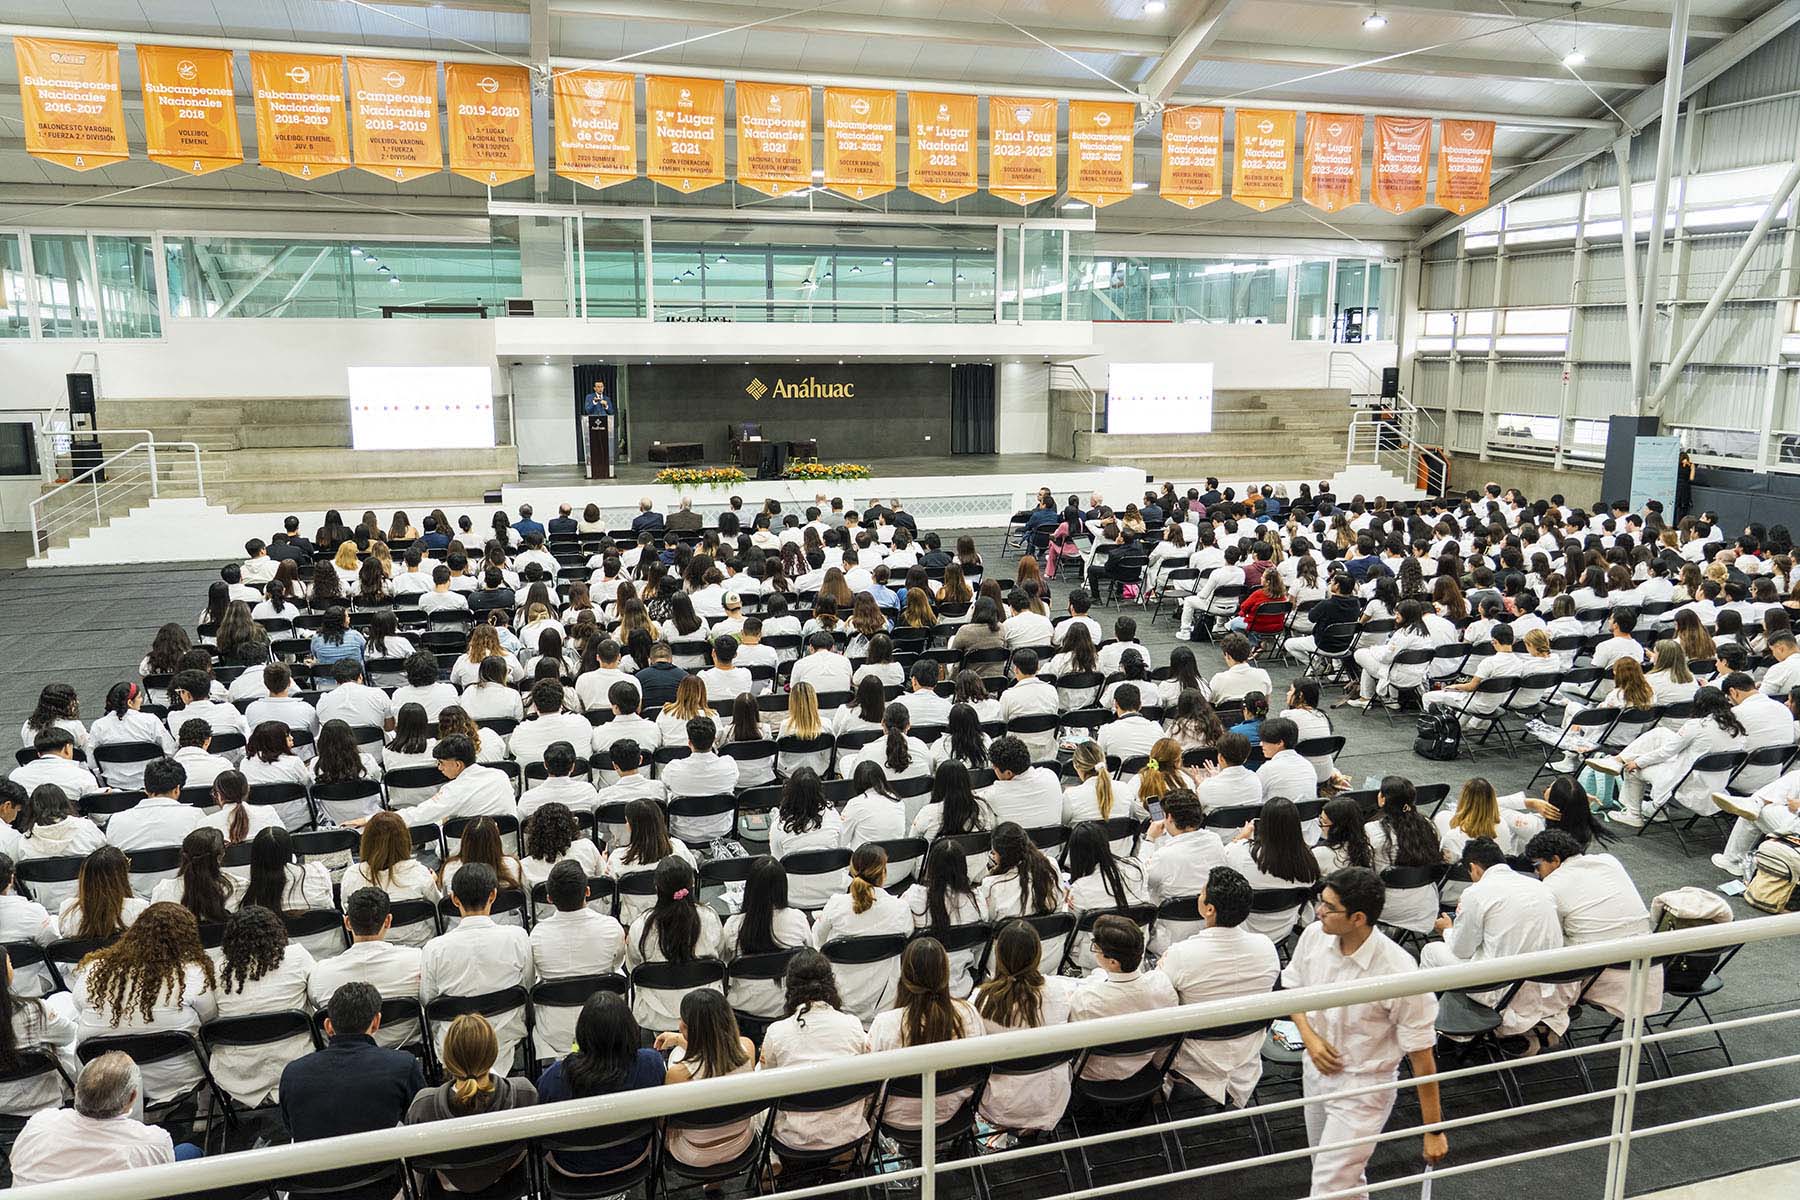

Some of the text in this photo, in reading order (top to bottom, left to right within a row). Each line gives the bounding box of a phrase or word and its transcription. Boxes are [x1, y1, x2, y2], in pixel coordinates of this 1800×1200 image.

[24, 76, 118, 91] Subcampeones
[145, 83, 233, 96] Subcampeones
[38, 89, 106, 102] Nacionales
[259, 90, 341, 102] Subcampeones
[357, 90, 432, 104] Campeones
[45, 102, 103, 114] 2016-2017
[159, 96, 222, 108] Nacionales
[270, 102, 331, 113] Nacionales
[179, 110, 205, 119] 2018
[360, 105, 431, 118] Nacionales
[459, 104, 520, 117] 2019-2020
[275, 114, 328, 125] 2018-2019
[571, 117, 619, 130] Medalla
[677, 112, 715, 127] Lugar
[743, 115, 807, 128] Campeones
[827, 120, 893, 131] Subcampeones
[39, 123, 82, 131] BALONCESTO
[366, 120, 428, 132] 2018-2019
[577, 131, 615, 142] de Oro
[656, 126, 714, 140] Nacional
[744, 128, 805, 141] Nacionales
[836, 131, 884, 141] Nacionales
[936, 126, 969, 139] Lugar
[995, 130, 1052, 143] Final Four
[1166, 133, 1219, 144] Campeones
[672, 142, 700, 155] 2021
[763, 143, 787, 153] 2021
[918, 140, 969, 152] Nacional
[1259, 137, 1285, 148] Lugar
[1328, 144, 1352, 153] Lugar
[1398, 142, 1422, 152] Lugar
[994, 145, 1053, 157] 2022-2023
[1168, 145, 1217, 155] Nacionales
[1245, 148, 1284, 158] Nacional
[930, 155, 957, 166] 2022
[1315, 154, 1352, 164] Nacional
[1383, 153, 1420, 162] Nacional
[772, 377, 855, 398] Anáhuac
